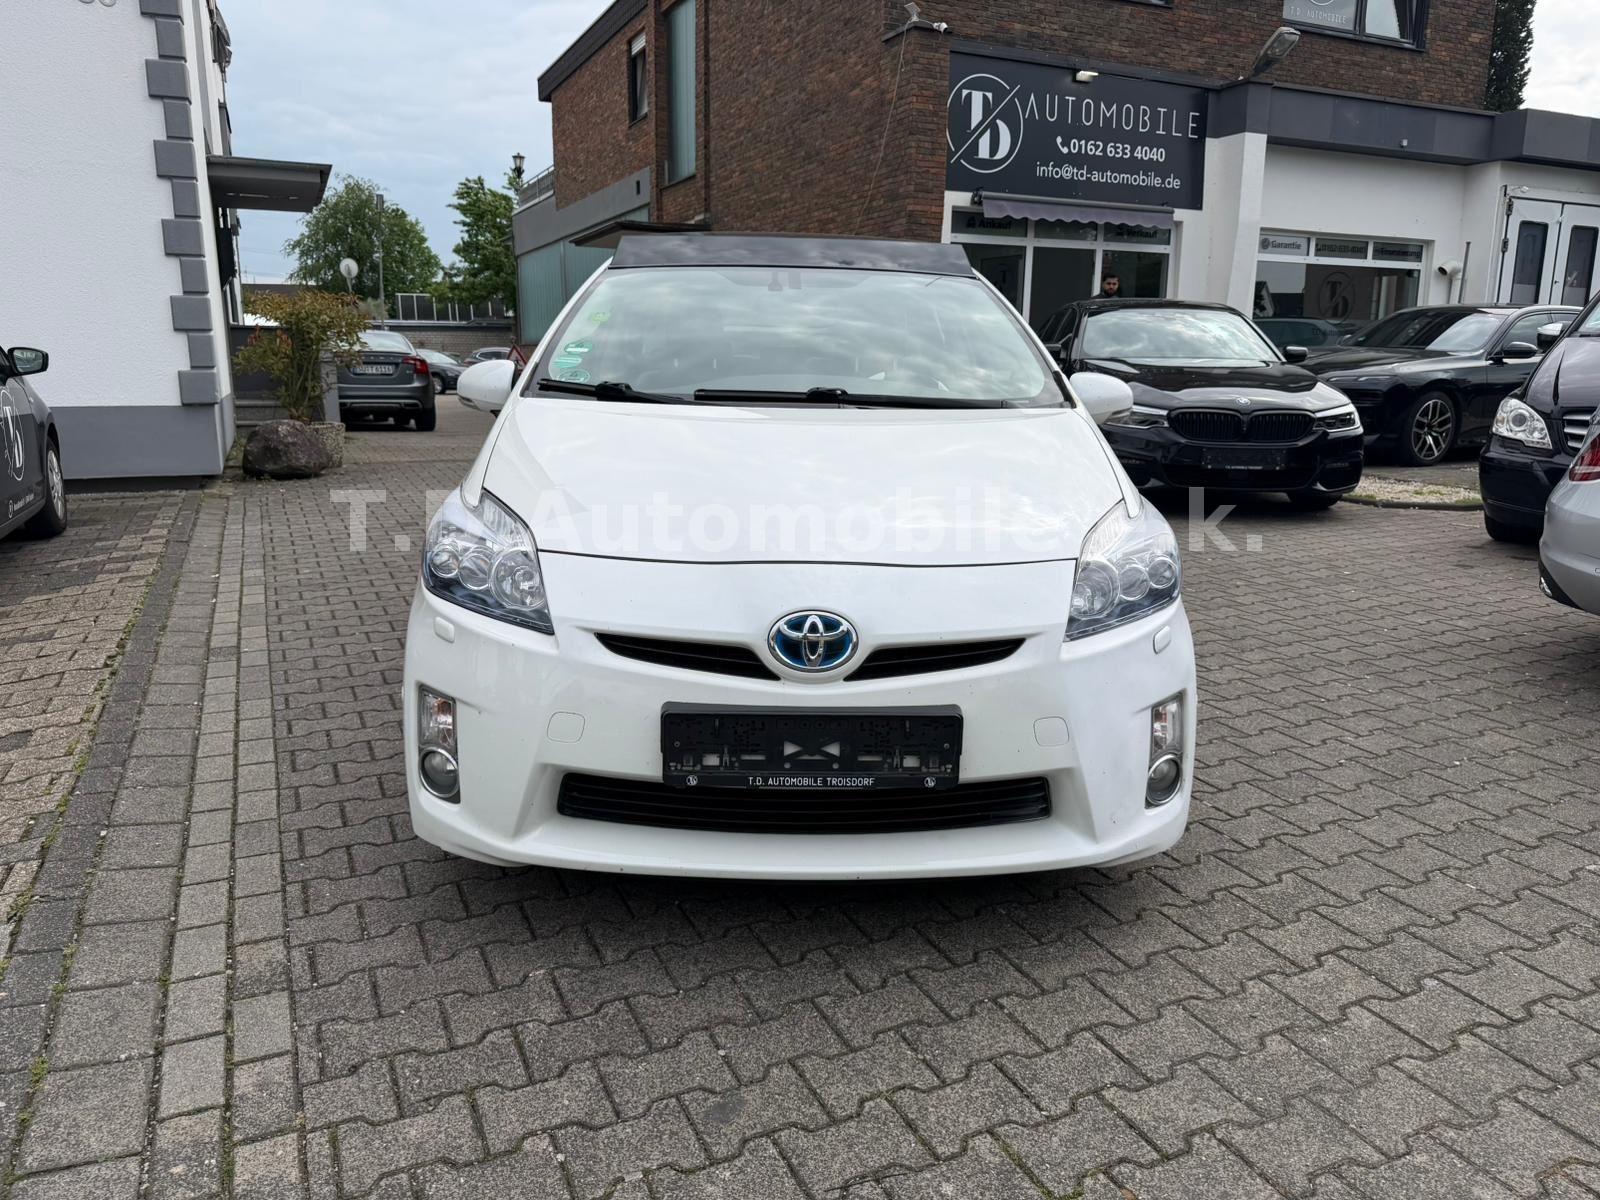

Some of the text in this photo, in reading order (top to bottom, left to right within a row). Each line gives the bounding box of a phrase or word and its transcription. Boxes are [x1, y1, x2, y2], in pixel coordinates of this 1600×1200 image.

[1025, 92, 1200, 138] AUTOMOBILE
[1070, 138, 1166, 162] 0162 633 4040
[1036, 161, 1181, 189] info@td-automobile.de
[1271, 240, 1302, 249] Garantie
[748, 776, 876, 787] T.D. AUTOMOBILE TROISDORF
